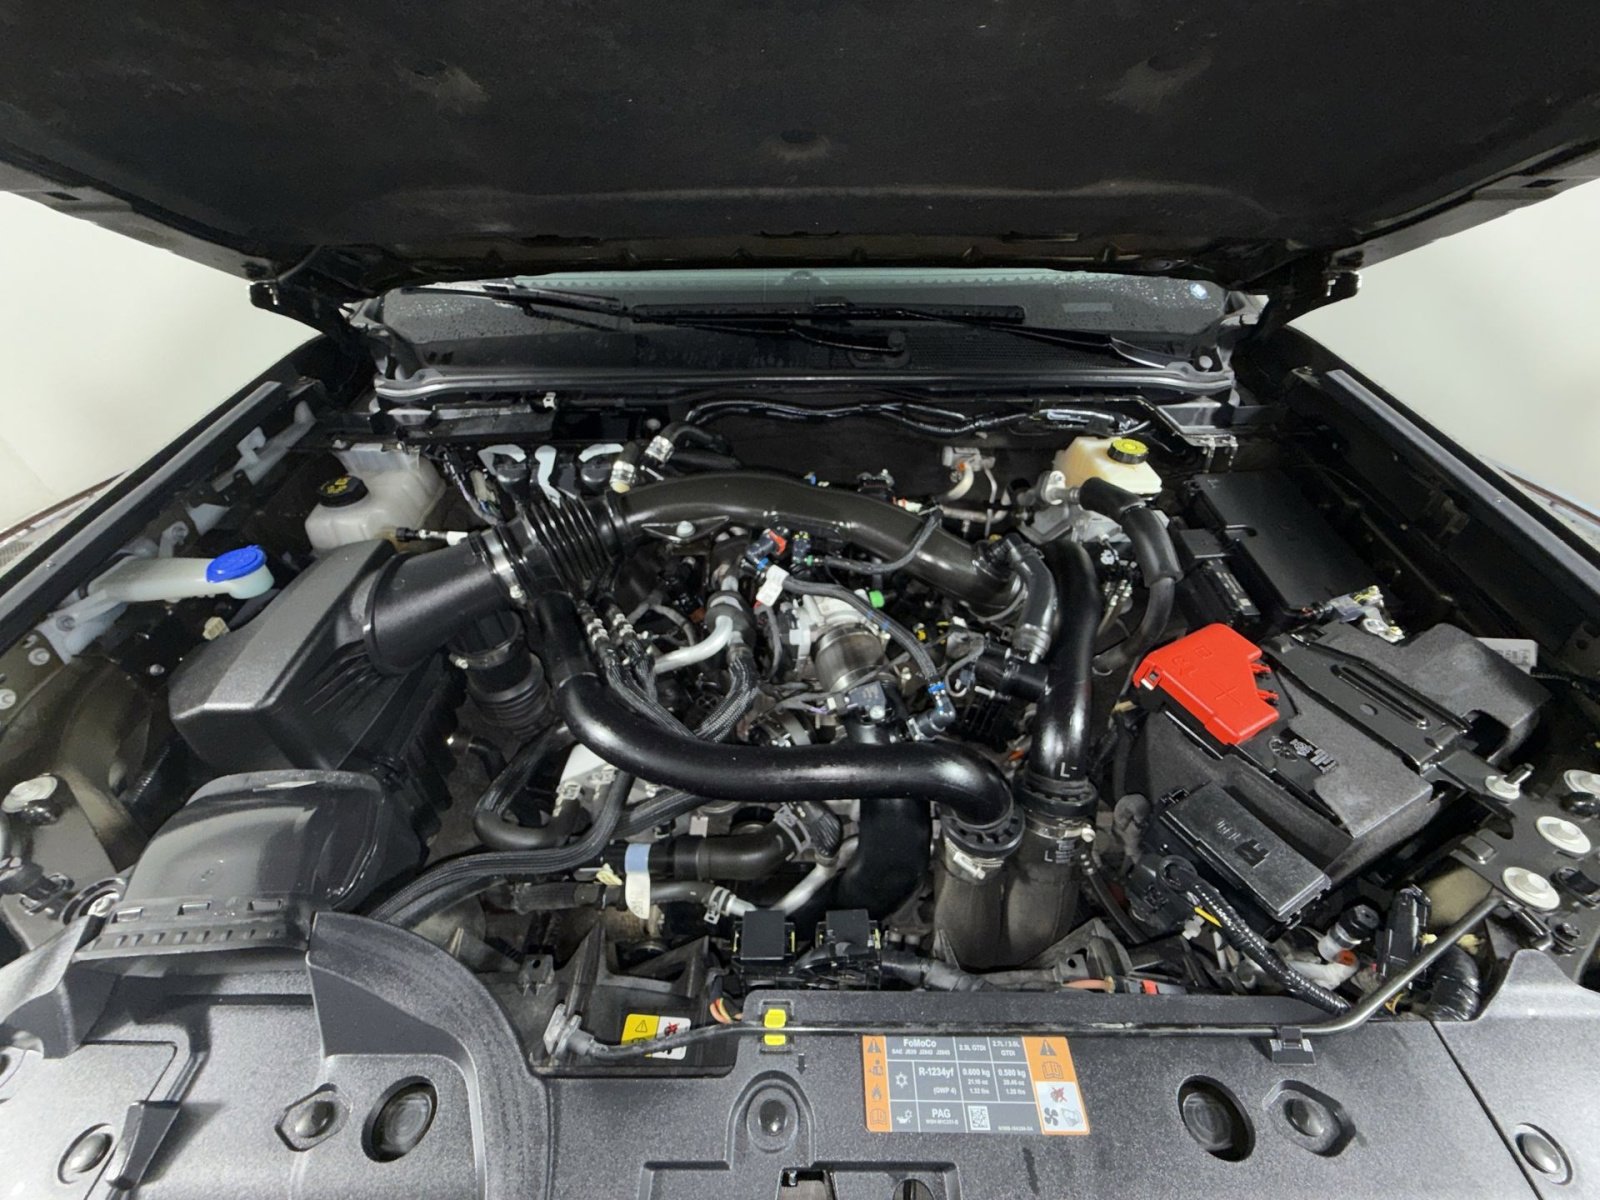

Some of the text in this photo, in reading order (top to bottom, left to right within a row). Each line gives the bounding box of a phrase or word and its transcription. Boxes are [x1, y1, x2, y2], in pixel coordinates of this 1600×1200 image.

[903, 1039, 937, 1048] FoMoCo
[918, 1067, 954, 1078] R-1234yf
[962, 1068, 991, 1078] 0.600 kg
[1017, 1069, 1026, 1079] kg
[931, 1108, 951, 1119] PAG
